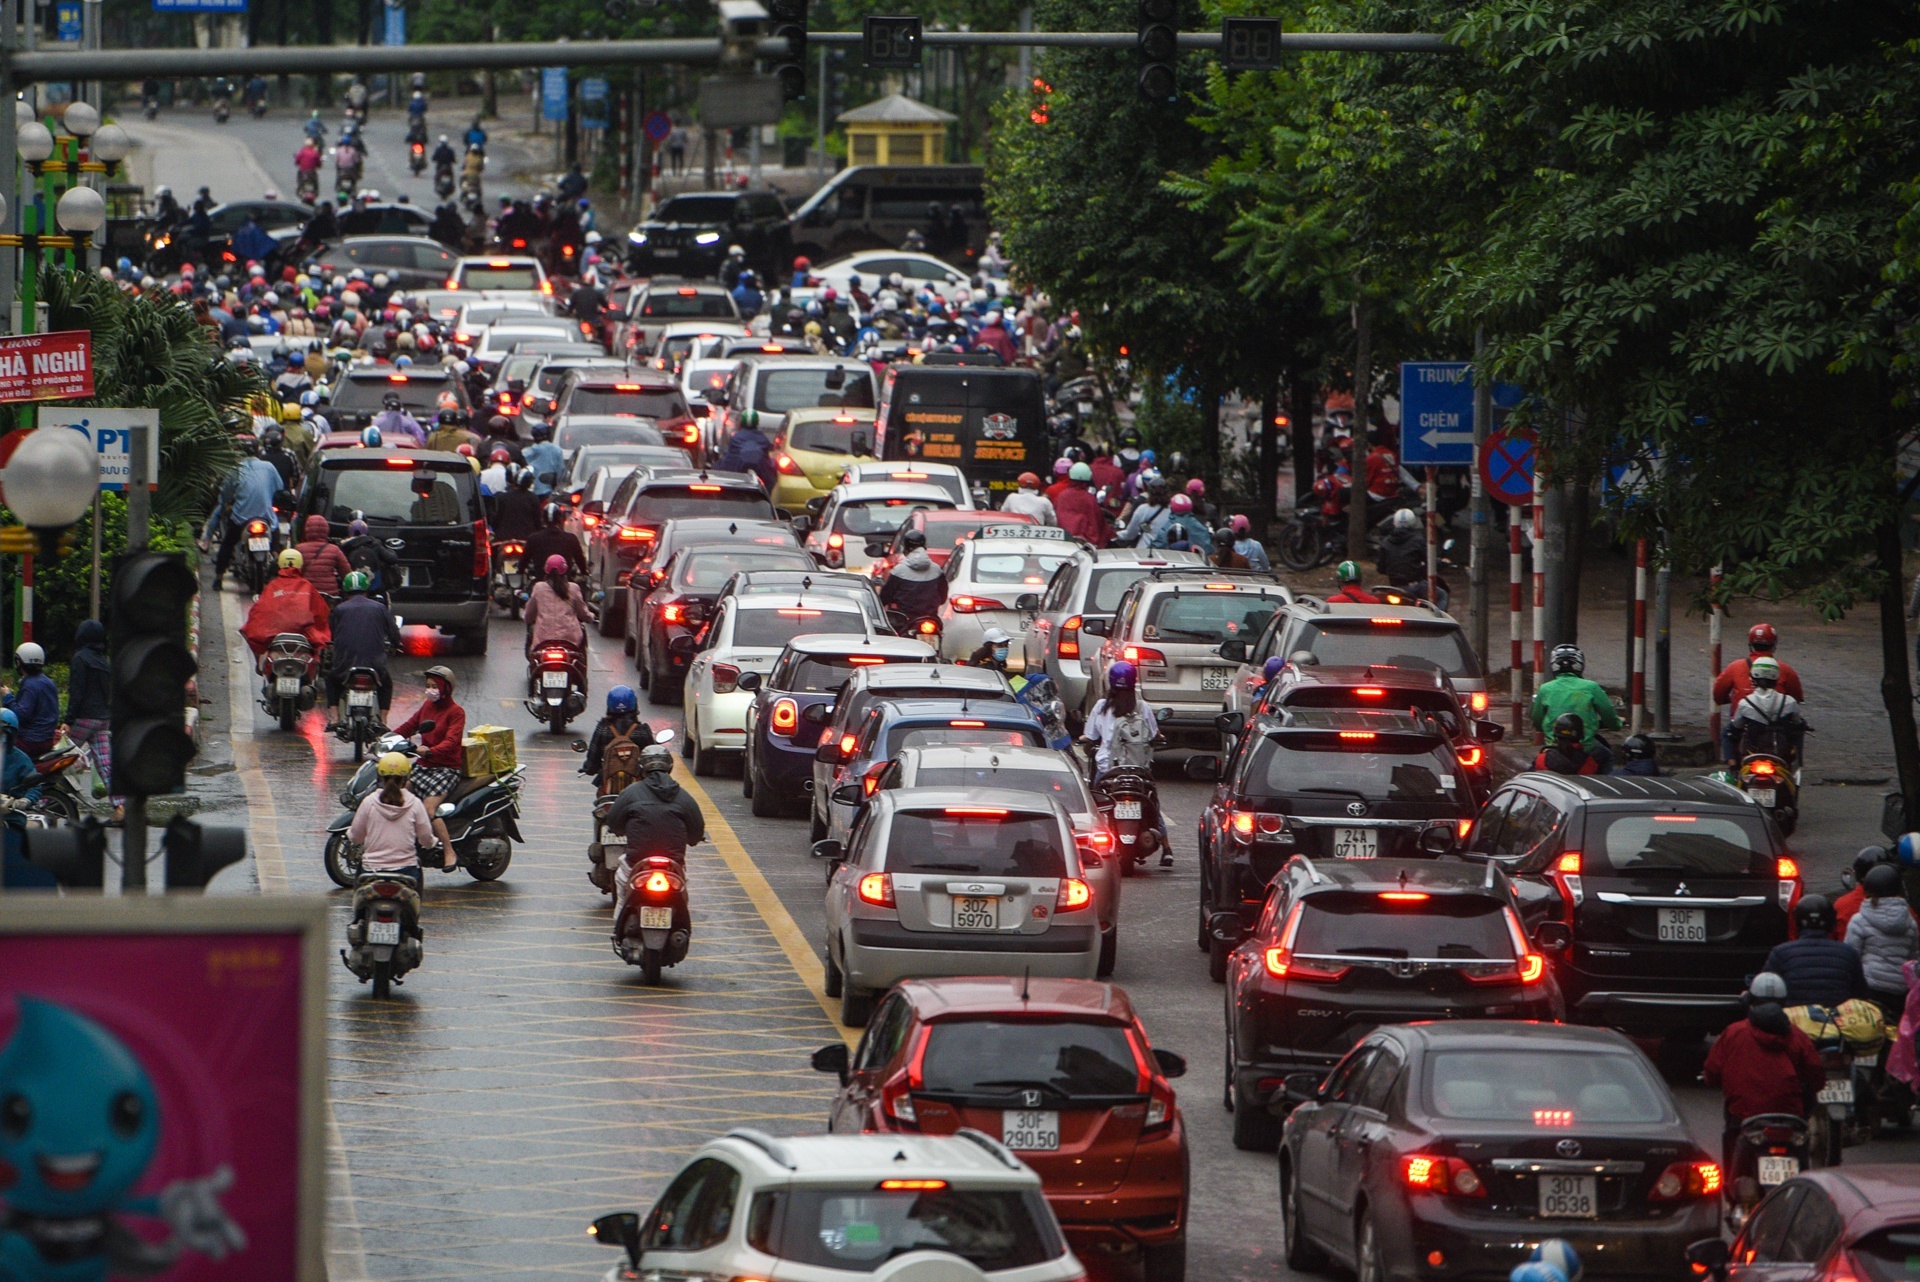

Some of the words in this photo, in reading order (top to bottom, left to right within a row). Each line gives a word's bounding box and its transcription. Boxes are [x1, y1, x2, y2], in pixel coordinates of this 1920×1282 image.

[32, 343, 86, 375] NGHỈ
[1419, 409, 1459, 427] CHÈM
[1210, 668, 1229, 679] 29A
[1344, 829, 1367, 843] 24A
[1335, 843, 1376, 857] 071.17
[962, 899, 988, 913] 30Z
[957, 913, 993, 927] 5970
[1669, 910, 1693, 924] 30F
[1660, 925, 1704, 939] 018.60
[1016, 1112, 1044, 1129] 30F
[1005, 1131, 1058, 1149] 290.50
[1551, 1177, 1584, 1194] 30T
[1545, 1196, 1591, 1213] 0538
